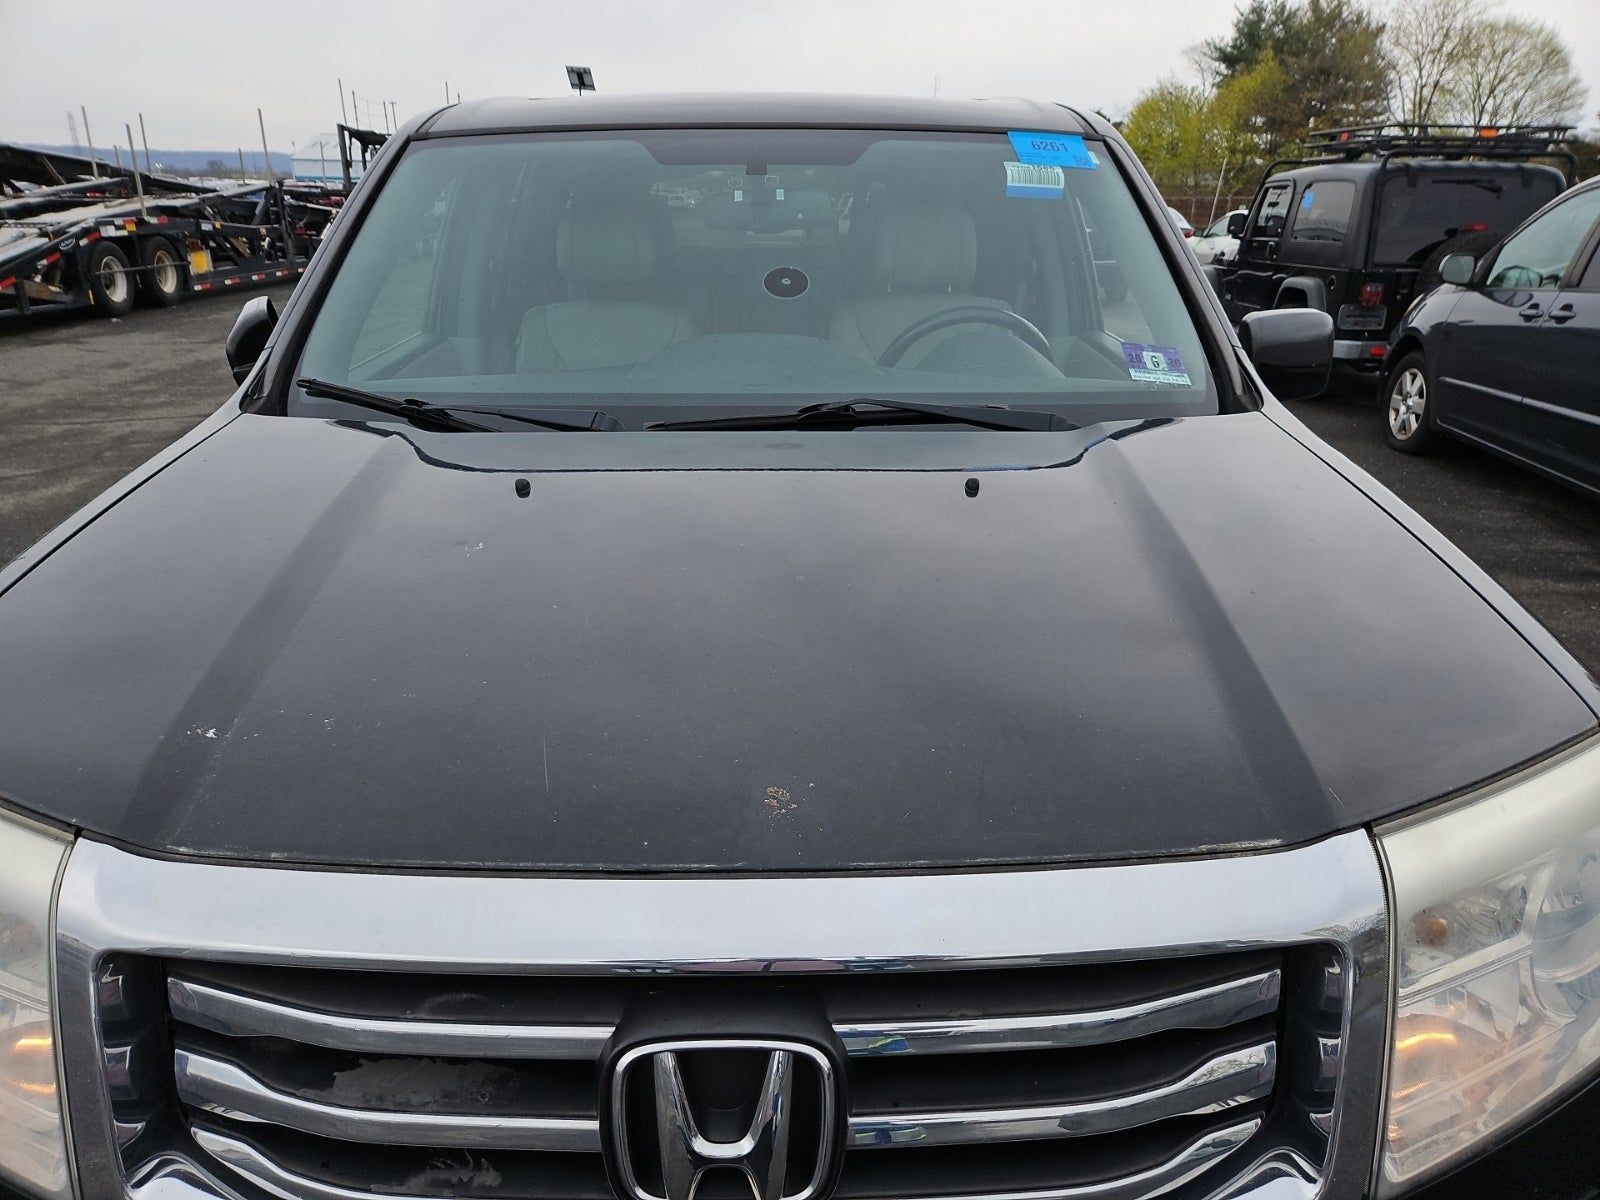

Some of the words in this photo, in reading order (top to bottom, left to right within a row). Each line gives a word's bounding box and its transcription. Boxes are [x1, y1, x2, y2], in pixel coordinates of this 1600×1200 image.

[1031, 140, 1069, 152] 6261
[1128, 354, 1142, 363] 20
[1150, 355, 1160, 369] 6
